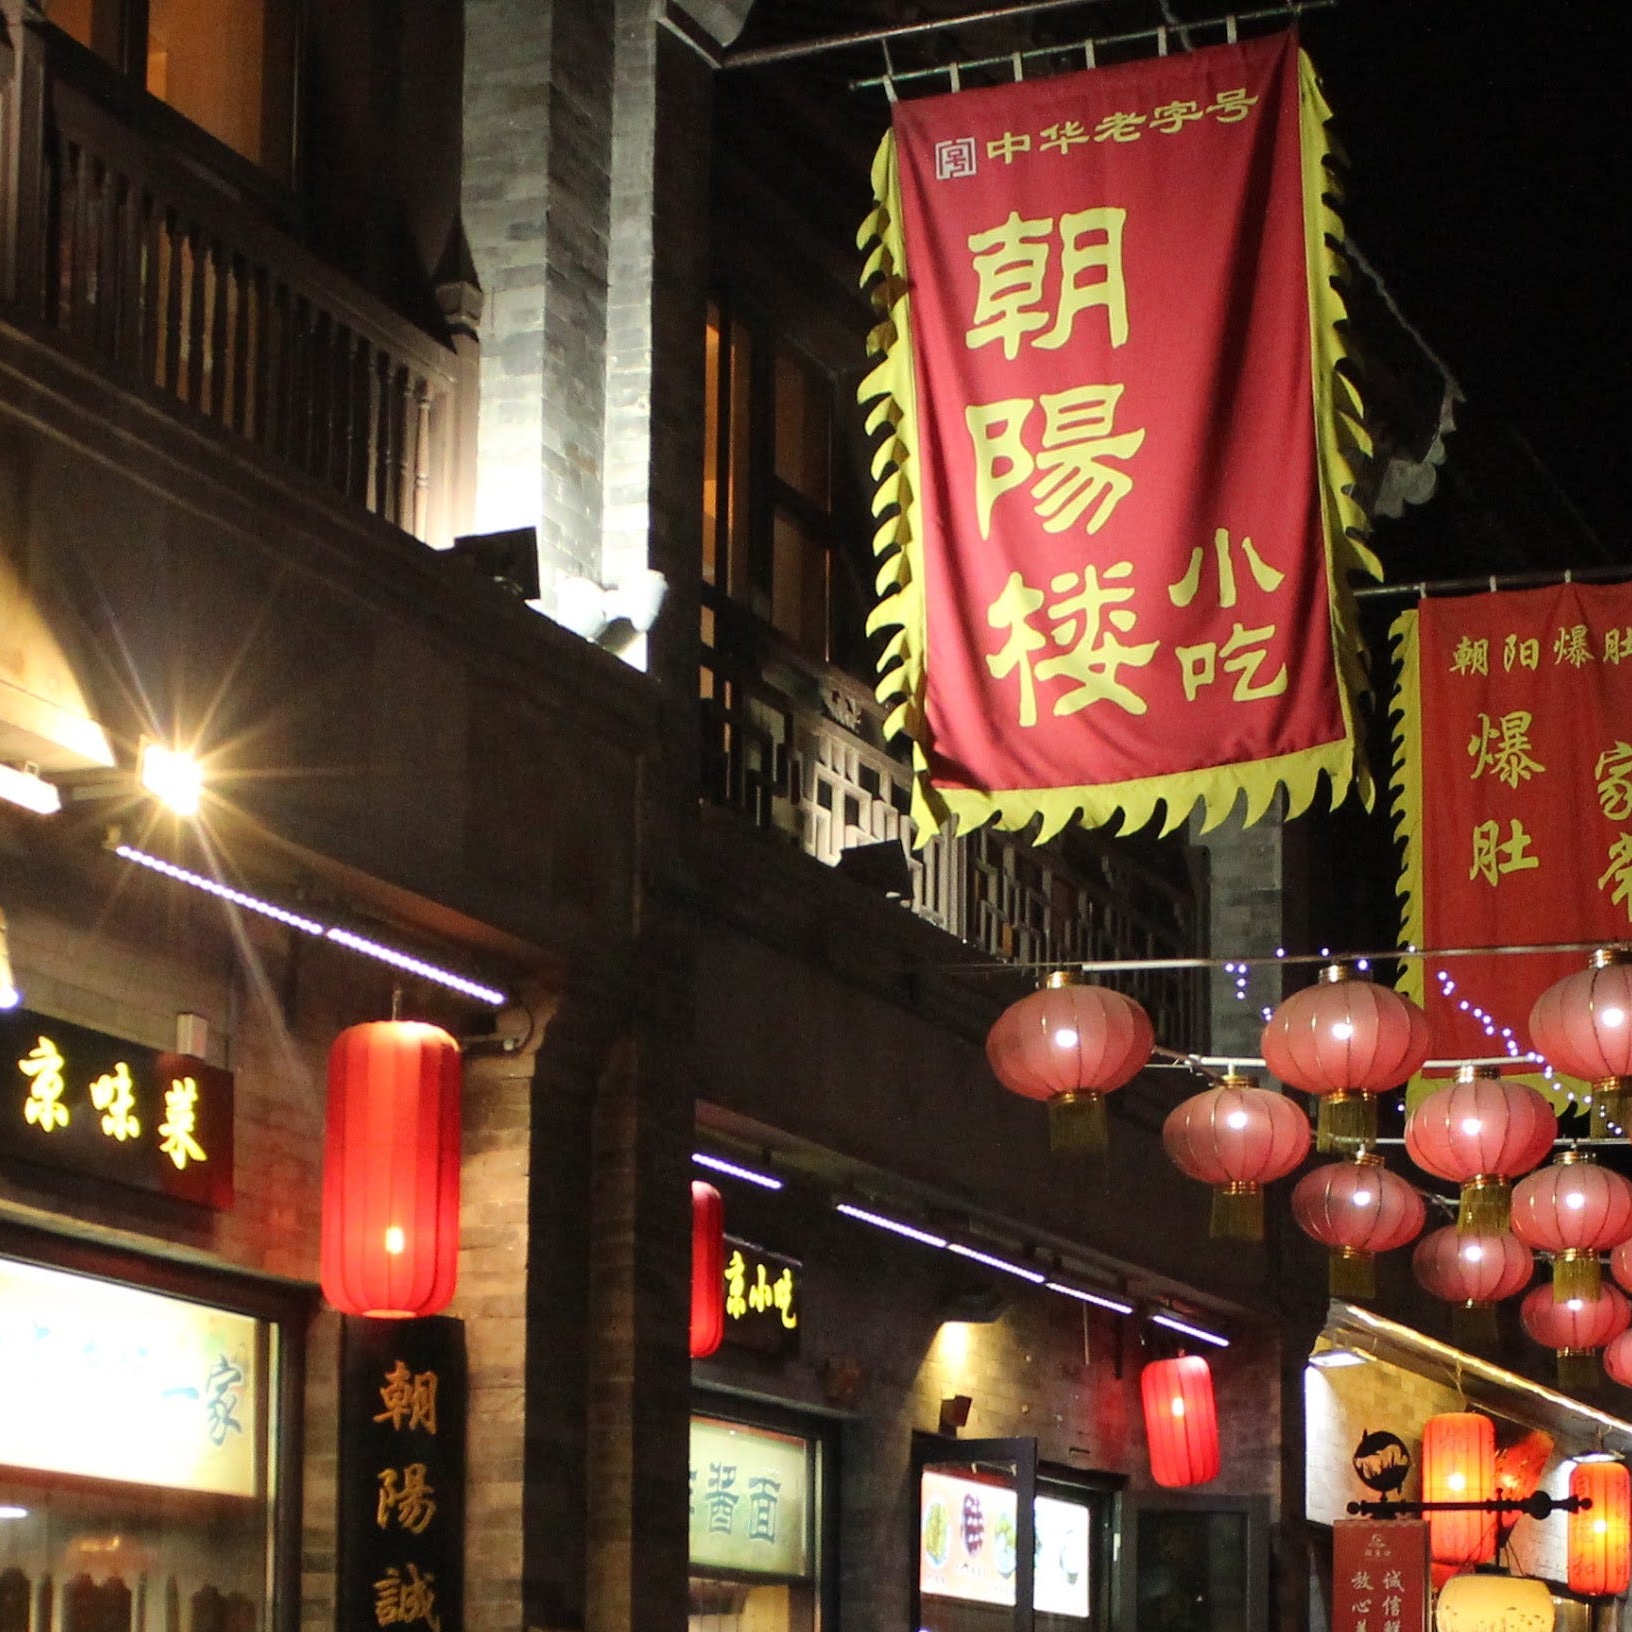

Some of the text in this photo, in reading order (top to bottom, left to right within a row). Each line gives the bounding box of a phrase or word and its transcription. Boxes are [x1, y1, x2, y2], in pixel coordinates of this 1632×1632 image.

[986, 87, 1259, 165] 中华老字号
[965, 206, 1162, 728] 朝陽楼
[1167, 527, 1287, 703] 小吃
[1467, 710, 1546, 888] 爆肚
[18, 1035, 208, 1171] 京味菜
[723, 1249, 798, 1330] 京小吃
